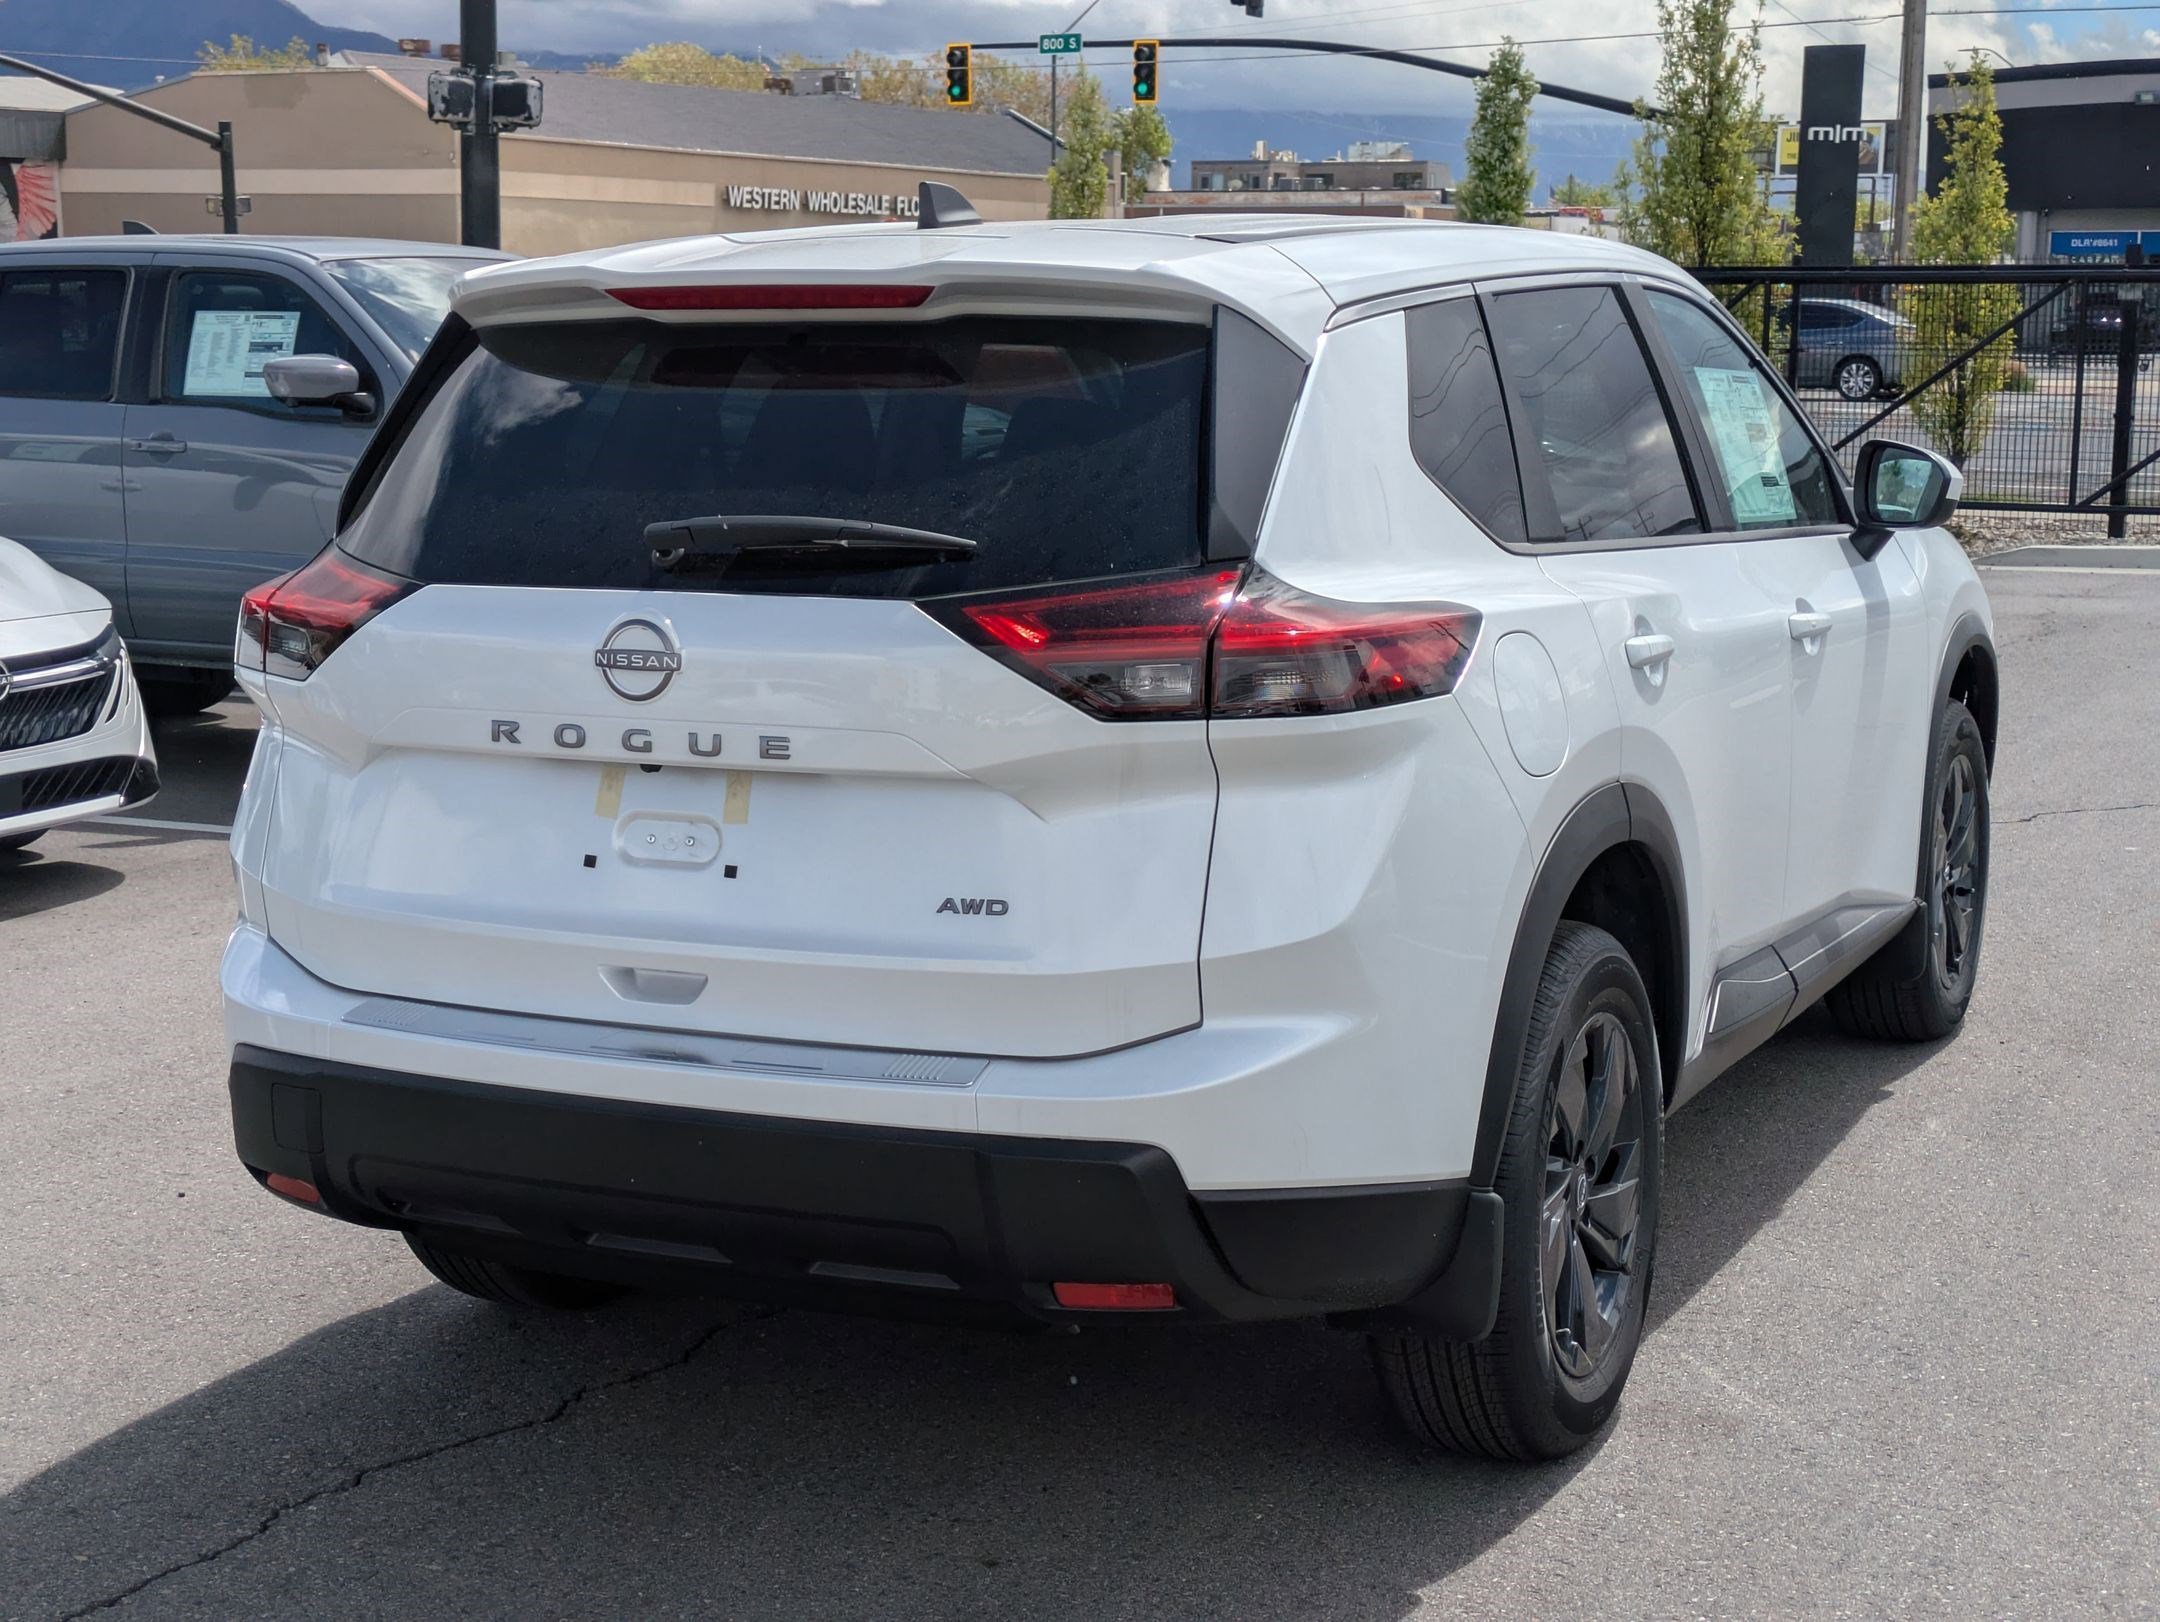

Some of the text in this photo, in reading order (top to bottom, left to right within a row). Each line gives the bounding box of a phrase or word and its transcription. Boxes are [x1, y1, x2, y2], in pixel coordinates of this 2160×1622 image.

[1042, 37, 1077, 50] 800 S
[727, 184, 800, 211] WESTERN
[806, 190, 890, 216] WHOLESALE
[596, 651, 679, 669] NISSAN
[491, 719, 791, 760] ROGUE
[936, 897, 1009, 916] AWD
